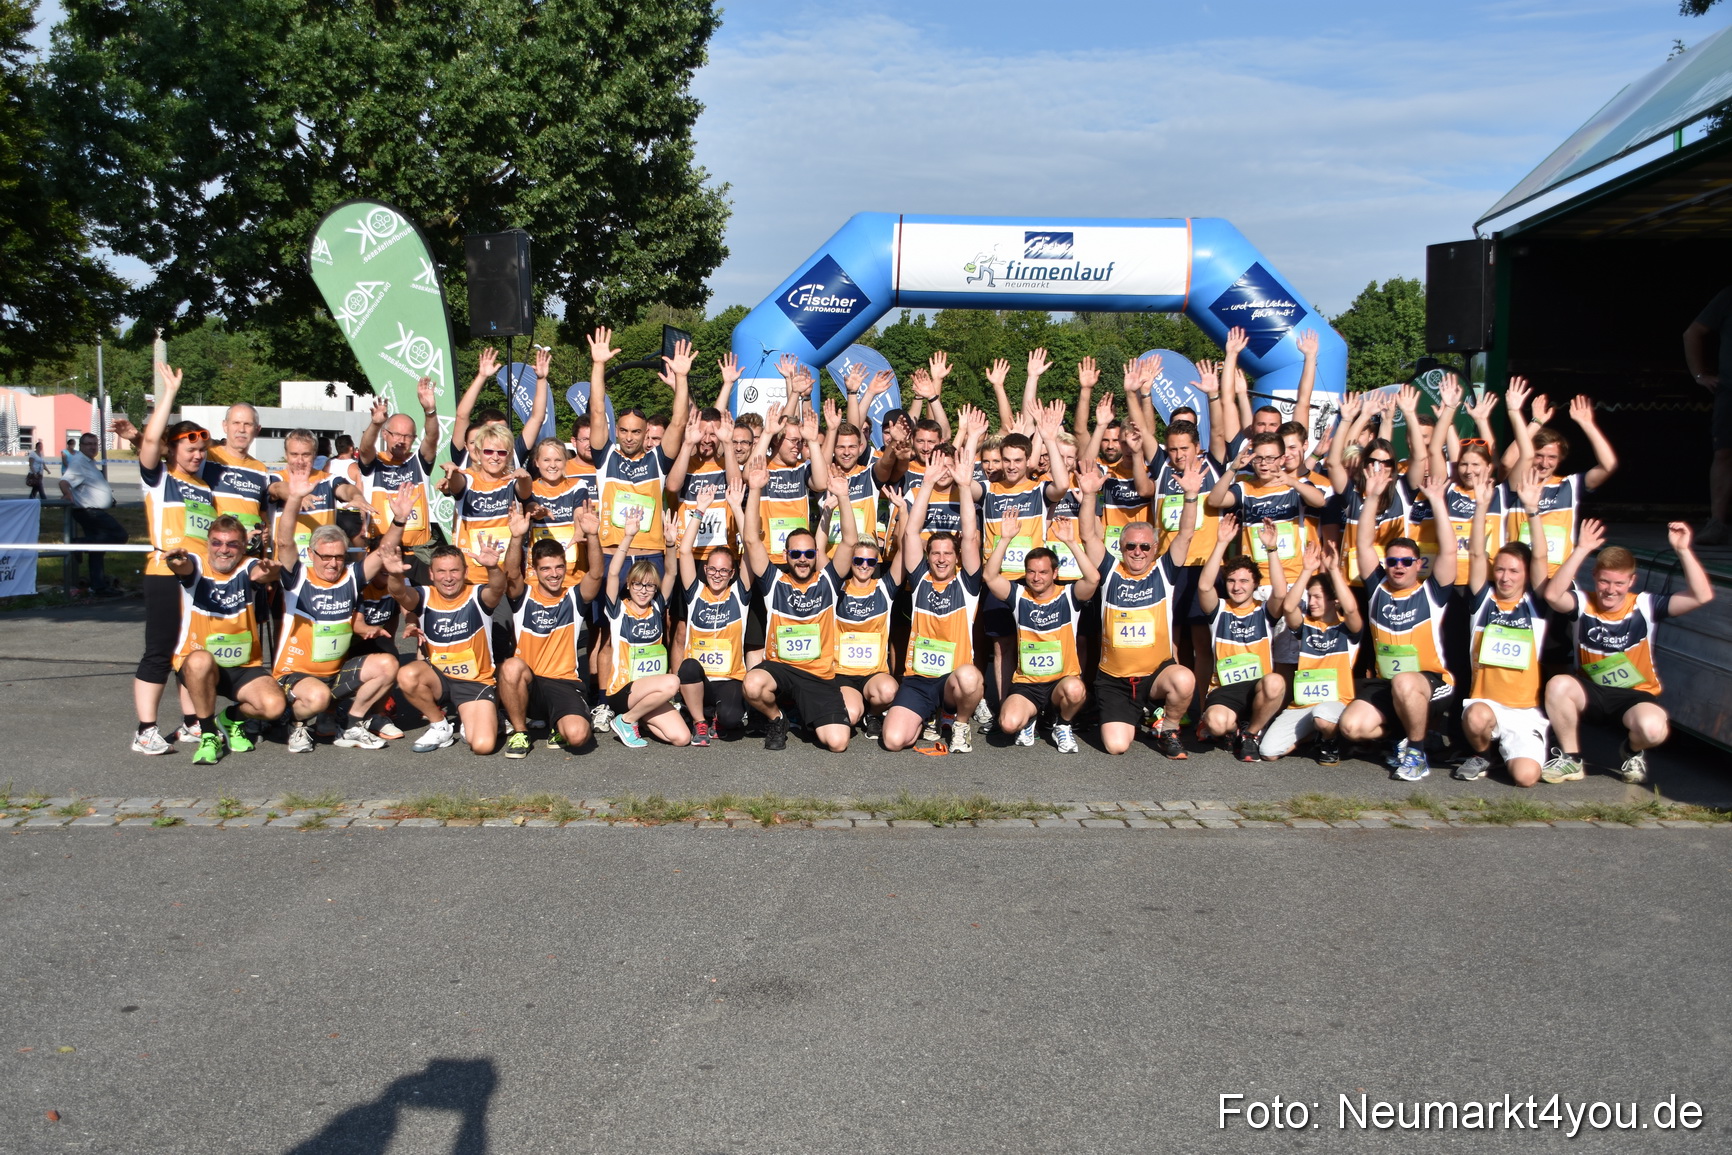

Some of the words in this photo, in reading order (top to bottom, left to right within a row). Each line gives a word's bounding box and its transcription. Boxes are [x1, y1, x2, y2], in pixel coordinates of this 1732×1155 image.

[1006, 260, 1115, 281] firmenlauf
[1005, 281, 1049, 289] neumarkt
[799, 294, 857, 307] Fischer
[770, 481, 801, 489] Fischer
[927, 513, 961, 521] Fischer
[1120, 625, 1146, 637] 414
[331, 639, 337, 650] 1
[786, 639, 812, 652] 397
[1491, 642, 1521, 657] 469
[214, 647, 242, 658] 406
[848, 647, 872, 659] 395
[699, 653, 723, 665] 465
[921, 652, 945, 667] 396
[1029, 656, 1055, 668] 423
[443, 664, 469, 675] 458
[637, 660, 661, 672] 420
[1392, 660, 1401, 672] 2
[1224, 666, 1258, 684] 1517
[1601, 668, 1629, 686] 470
[1303, 685, 1330, 697] 445
